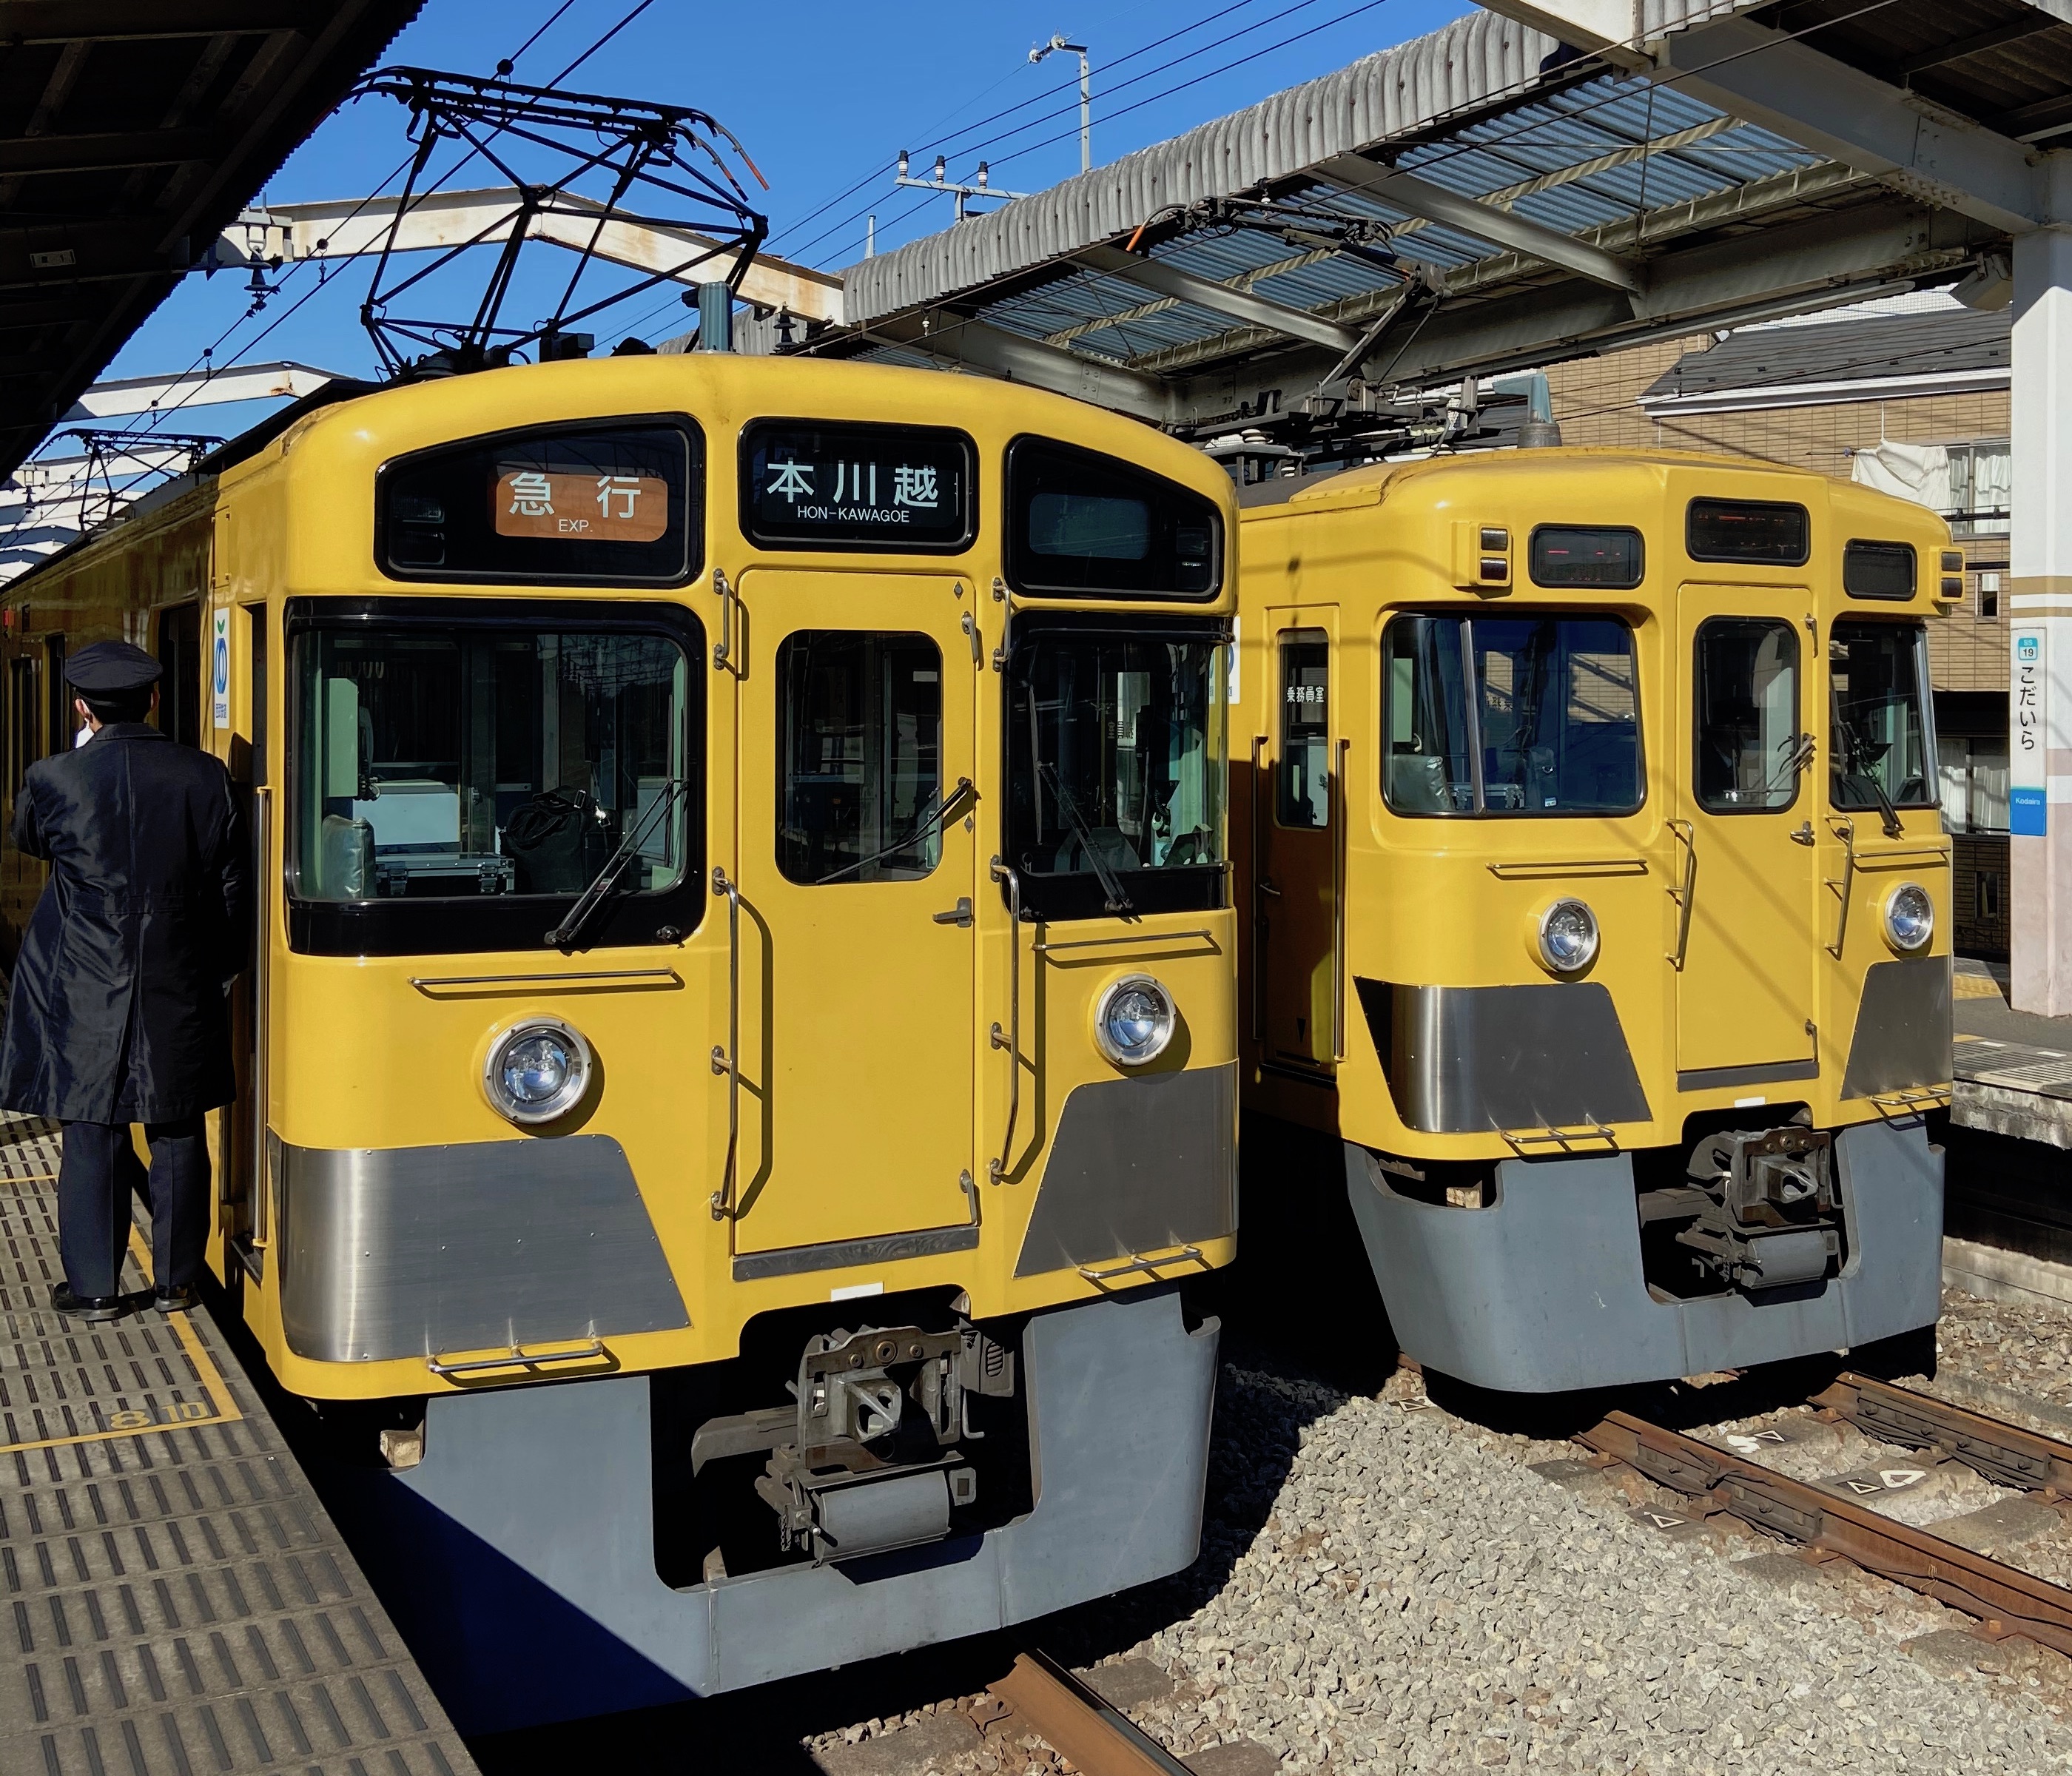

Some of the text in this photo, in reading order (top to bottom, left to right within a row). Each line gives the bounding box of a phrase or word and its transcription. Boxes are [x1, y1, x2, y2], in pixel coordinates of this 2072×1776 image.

[767, 457, 938, 508] 本川越
[508, 472, 641, 518] 急行
[797, 505, 910, 523] HON-KAWAGOE
[558, 519, 593, 533] EXP.
[2023, 648, 2034, 657] 19
[1287, 686, 1325, 703] 乗務員室
[2019, 666, 2037, 750] こだいら
[111, 1402, 209, 1429] 8 10
